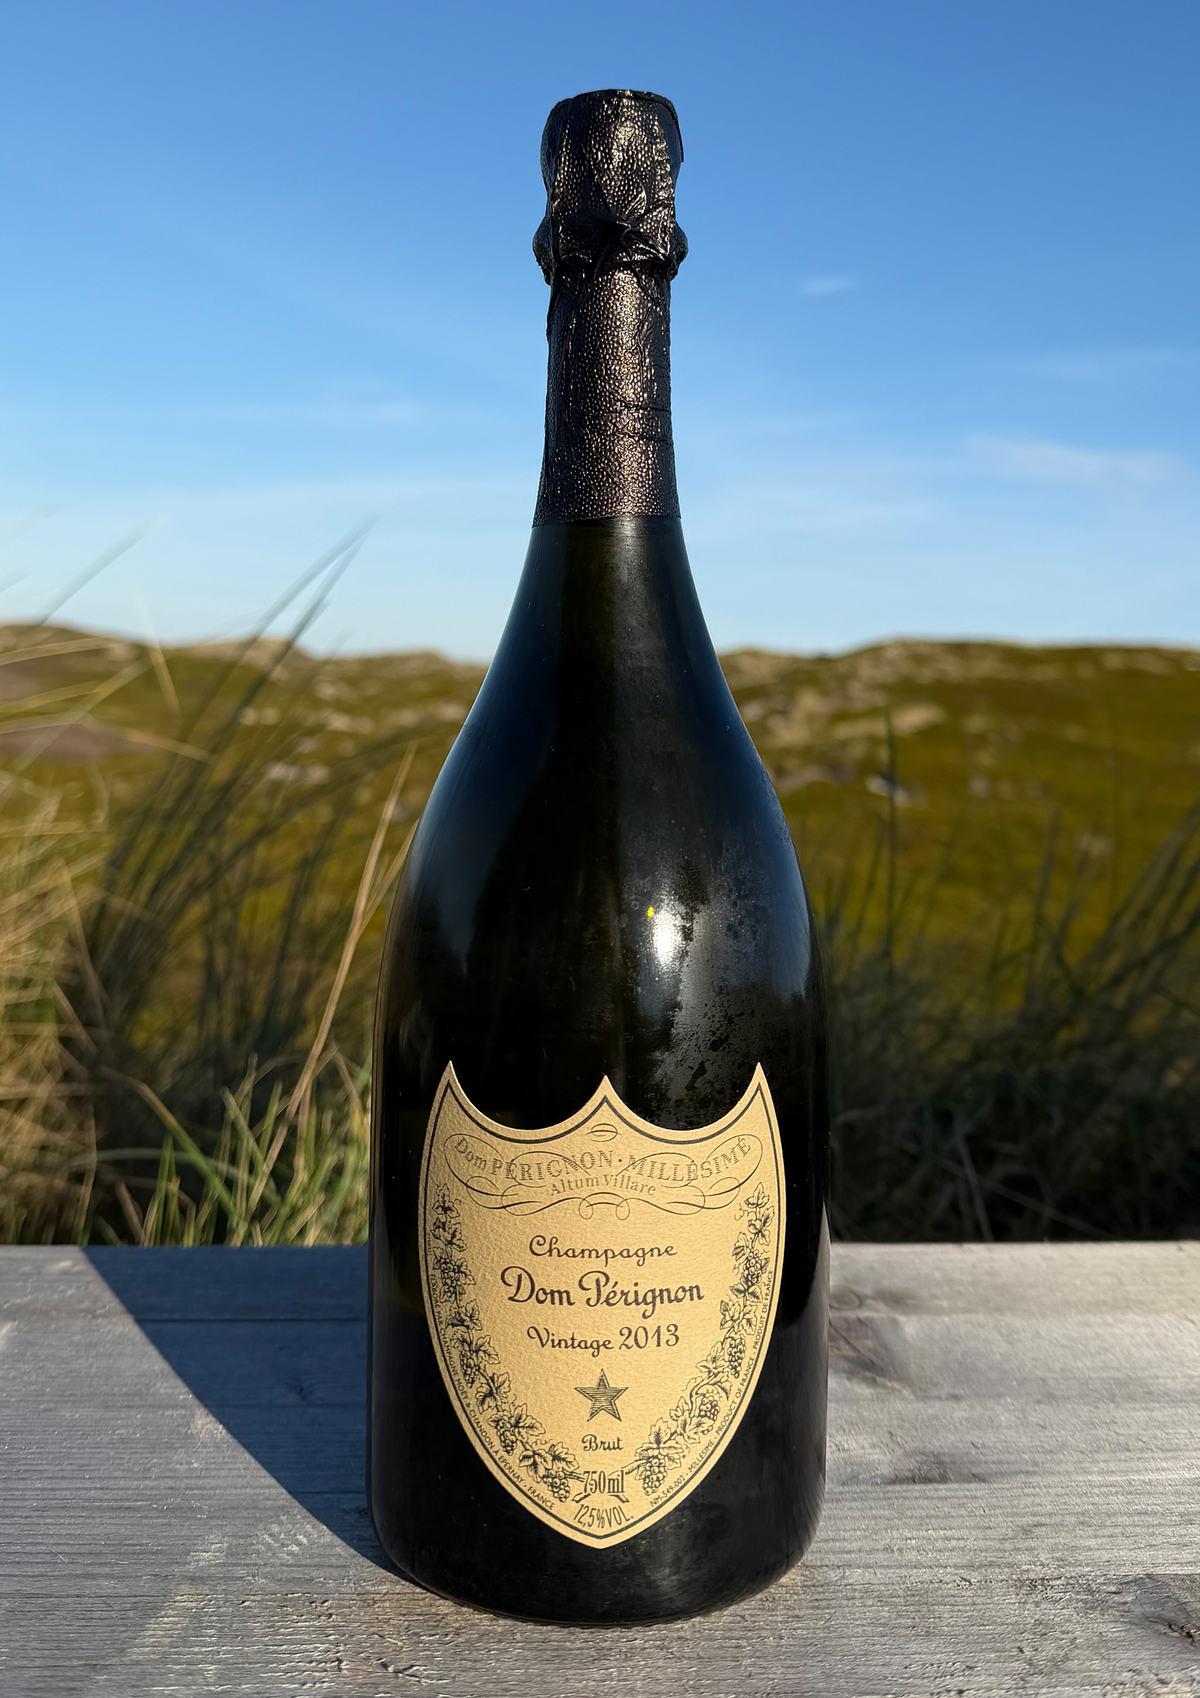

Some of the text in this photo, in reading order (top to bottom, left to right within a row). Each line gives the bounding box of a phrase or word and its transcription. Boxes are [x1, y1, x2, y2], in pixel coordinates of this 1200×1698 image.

[455, 1136, 487, 1171] Dom
[551, 1174, 656, 1196] Altum Villare
[529, 1235, 678, 1267] Champagne
[501, 1266, 704, 1319] Dom Pérignon
[527, 1323, 680, 1358] Vintage 2013
[715, 1401, 737, 1435] PRODUCT
[740, 1357, 754, 1387] FRANCE
[469, 1409, 496, 1449] CHANDON
[528, 1486, 555, 1510] FRANCE
[581, 1434, 623, 1451] Brut
[583, 1470, 625, 1494] 750ml
